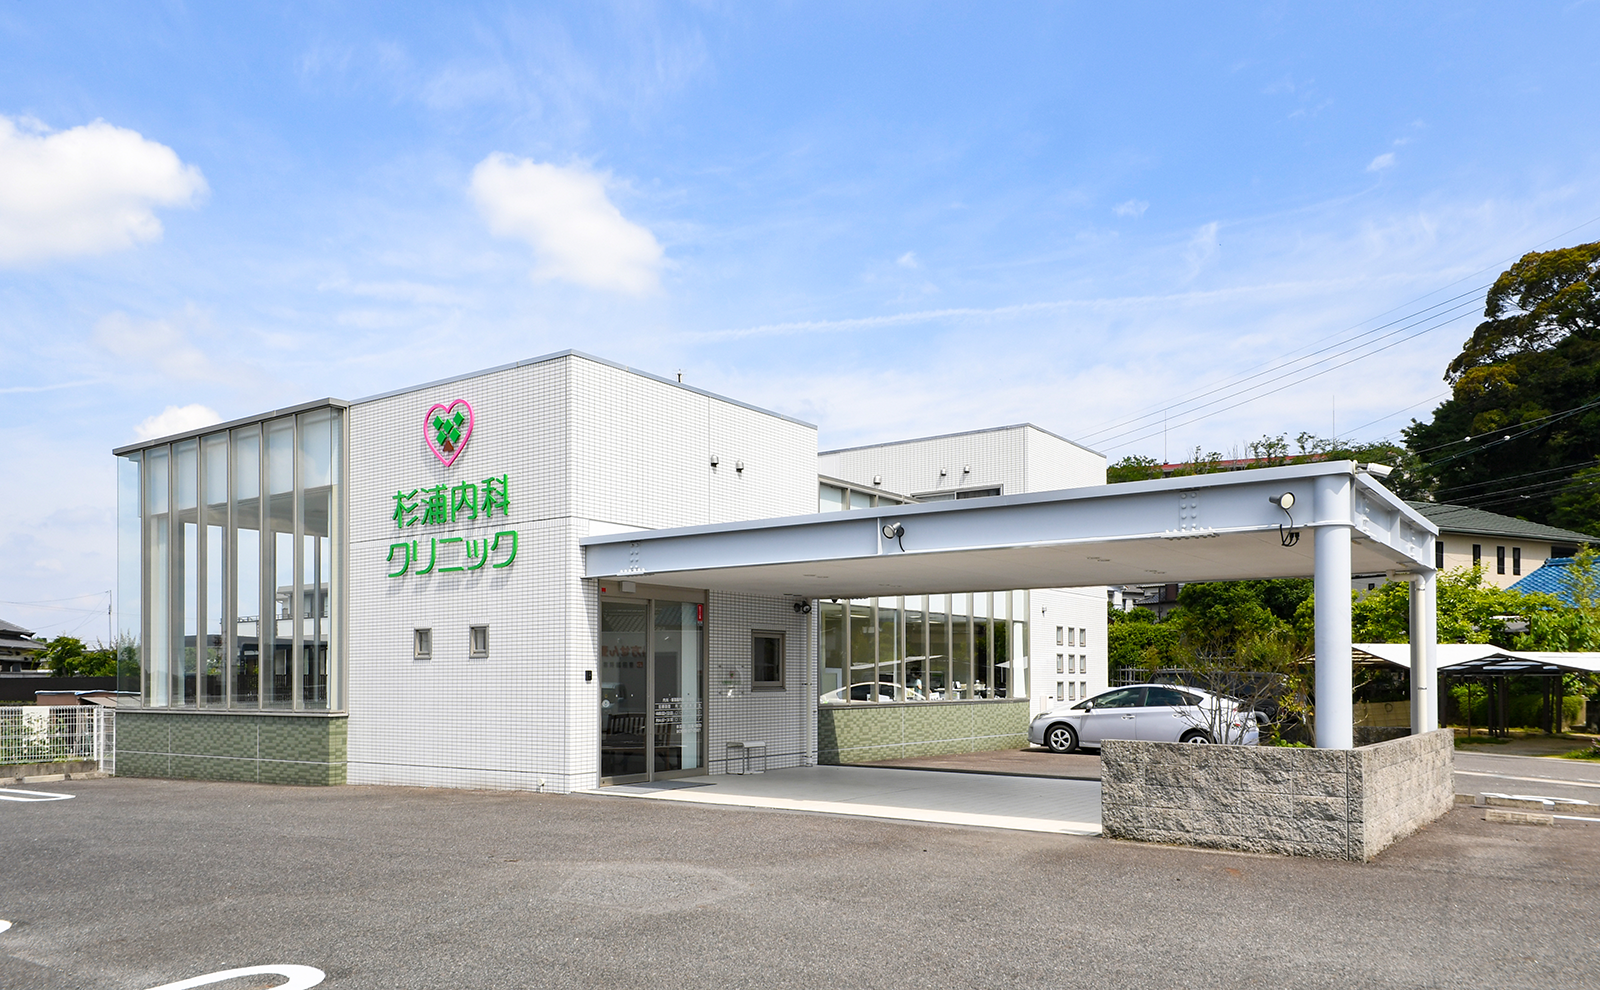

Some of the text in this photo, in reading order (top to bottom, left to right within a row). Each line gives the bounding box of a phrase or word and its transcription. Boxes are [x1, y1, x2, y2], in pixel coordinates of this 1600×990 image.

[392, 473, 511, 529] 杉浦内科
[386, 530, 518, 578] クリニック
